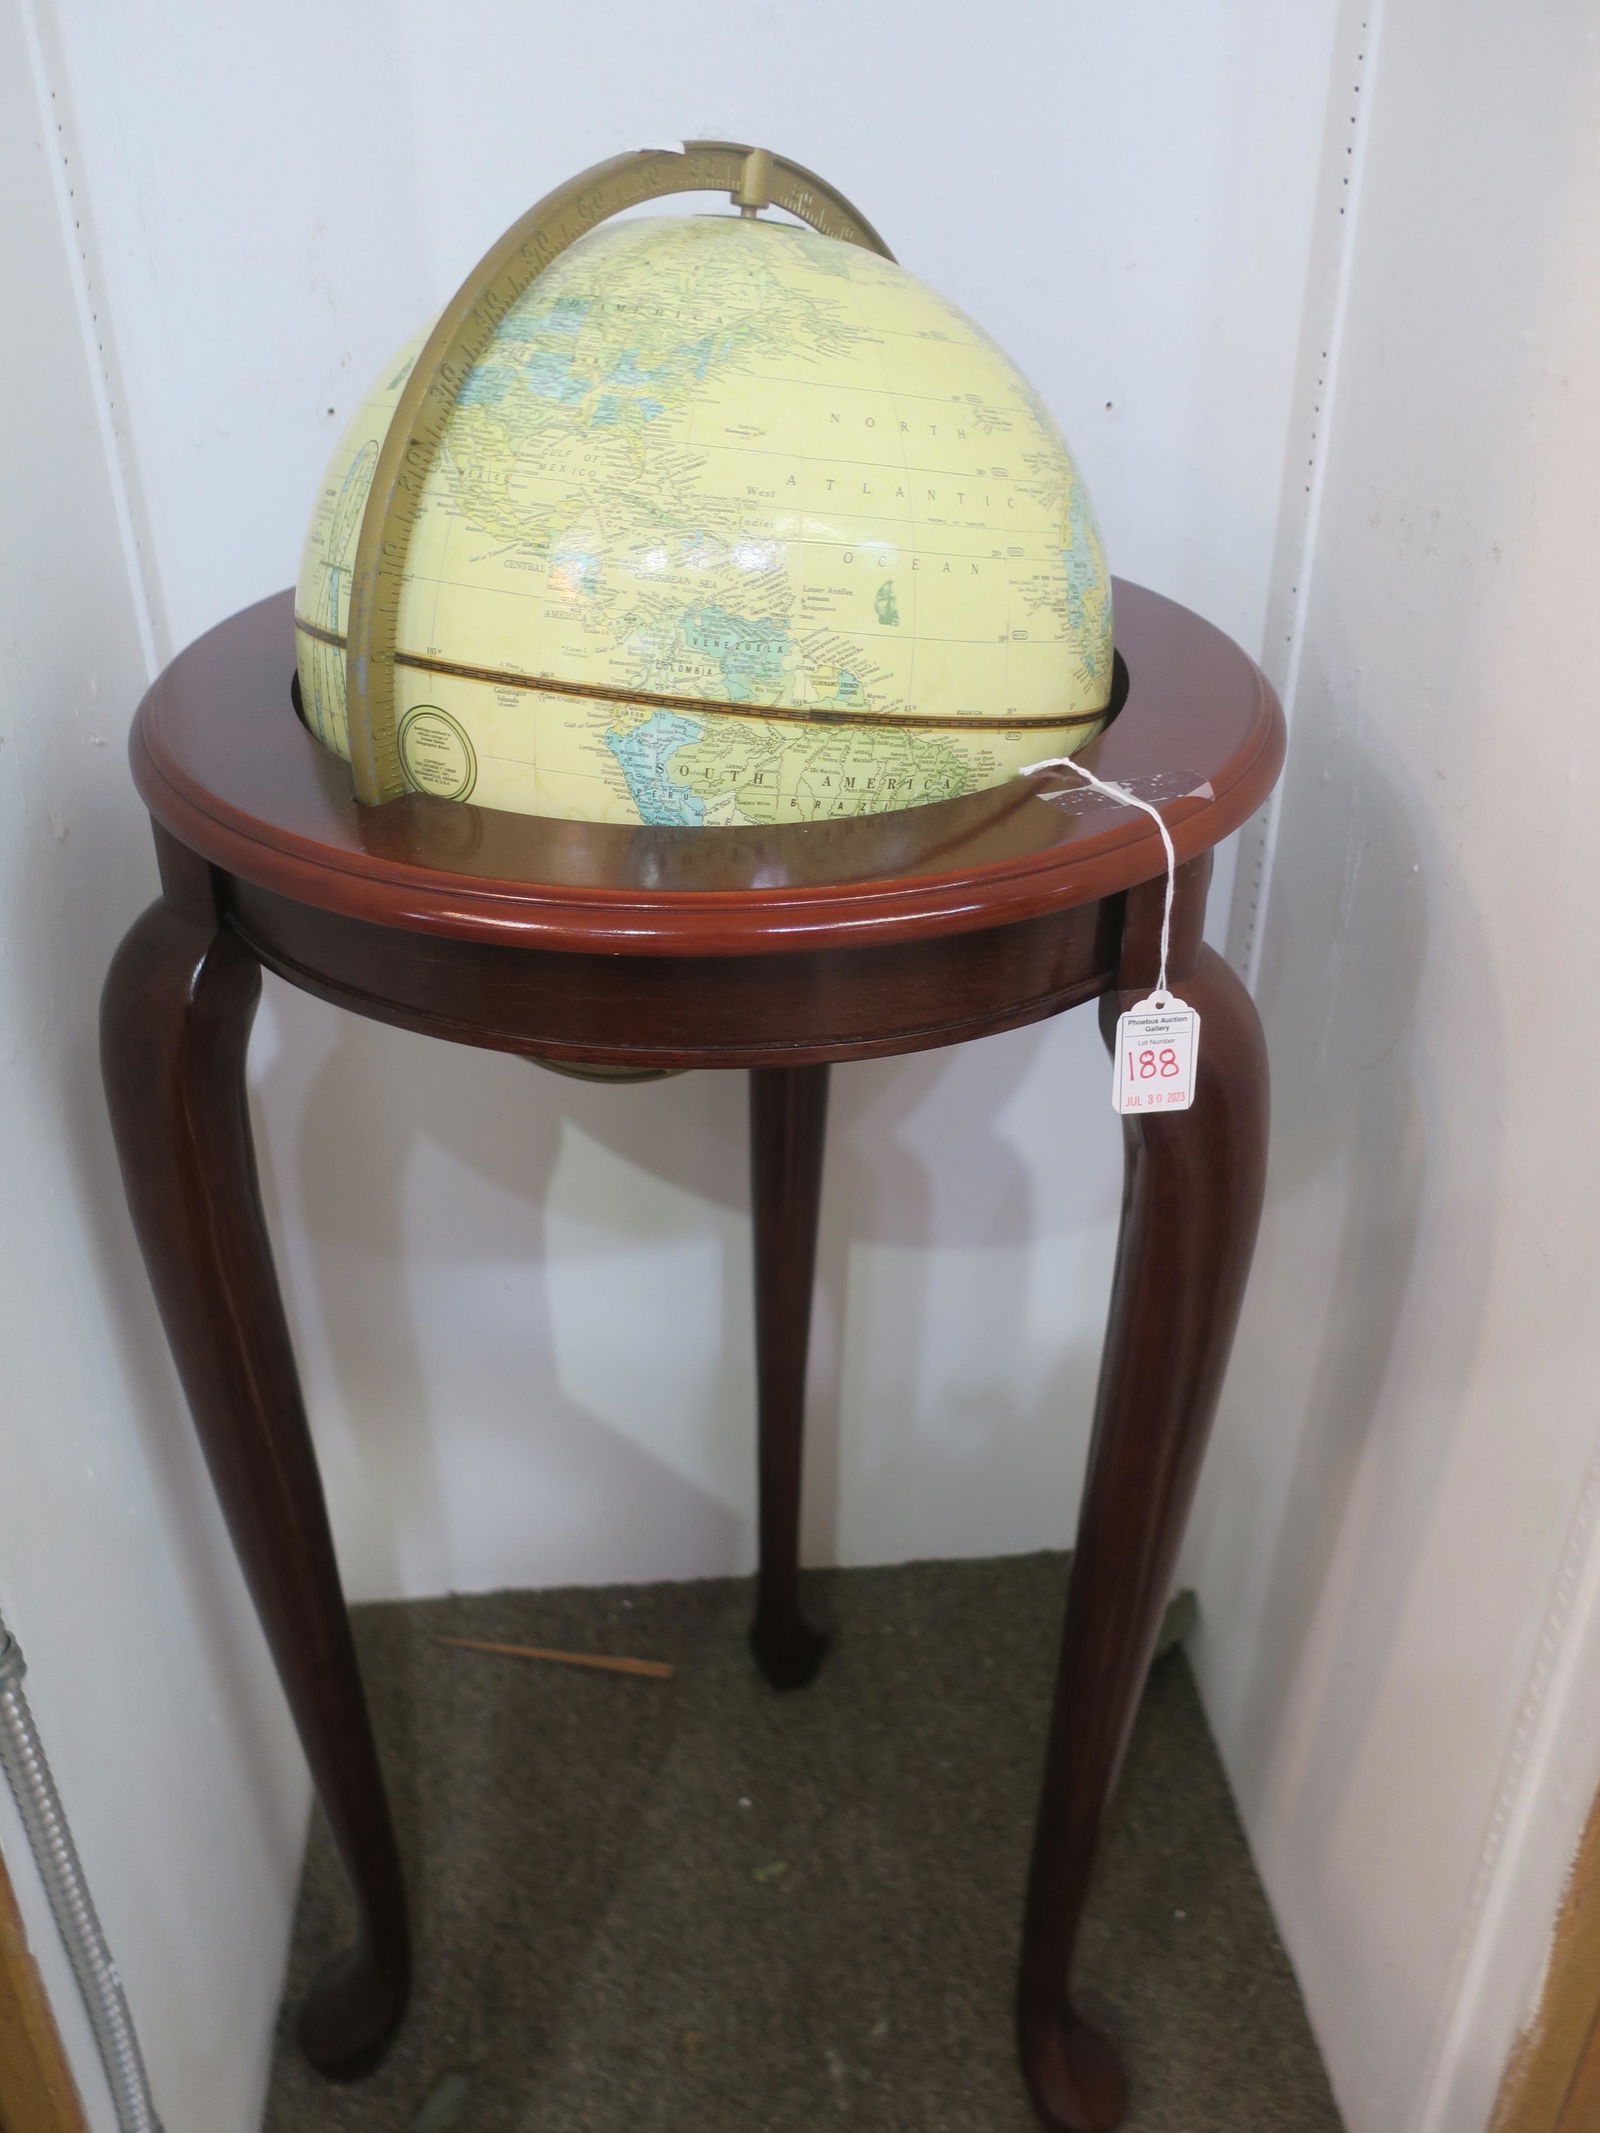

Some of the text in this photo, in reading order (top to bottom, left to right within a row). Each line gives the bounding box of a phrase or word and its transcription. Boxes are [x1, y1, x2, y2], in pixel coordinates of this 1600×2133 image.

[830, 411, 967, 439] NORTH
[747, 486, 776, 498] West
[785, 474, 1016, 509] ATLANTIC
[843, 551, 980, 575] OCEAN
[692, 637, 783, 654] VENEZUELA
[656, 661, 713, 677] COLOMBIA
[655, 762, 765, 784] SOUTH
[821, 775, 951, 790] AMERICA
[636, 789, 689, 800] PERU
[1128, 1015, 1188, 1026] Phoebus Auction
[1145, 1025, 1170, 1033] Gallery
[1128, 1048, 1180, 1081] 188
[1126, 1096, 1142, 1107] JUL
